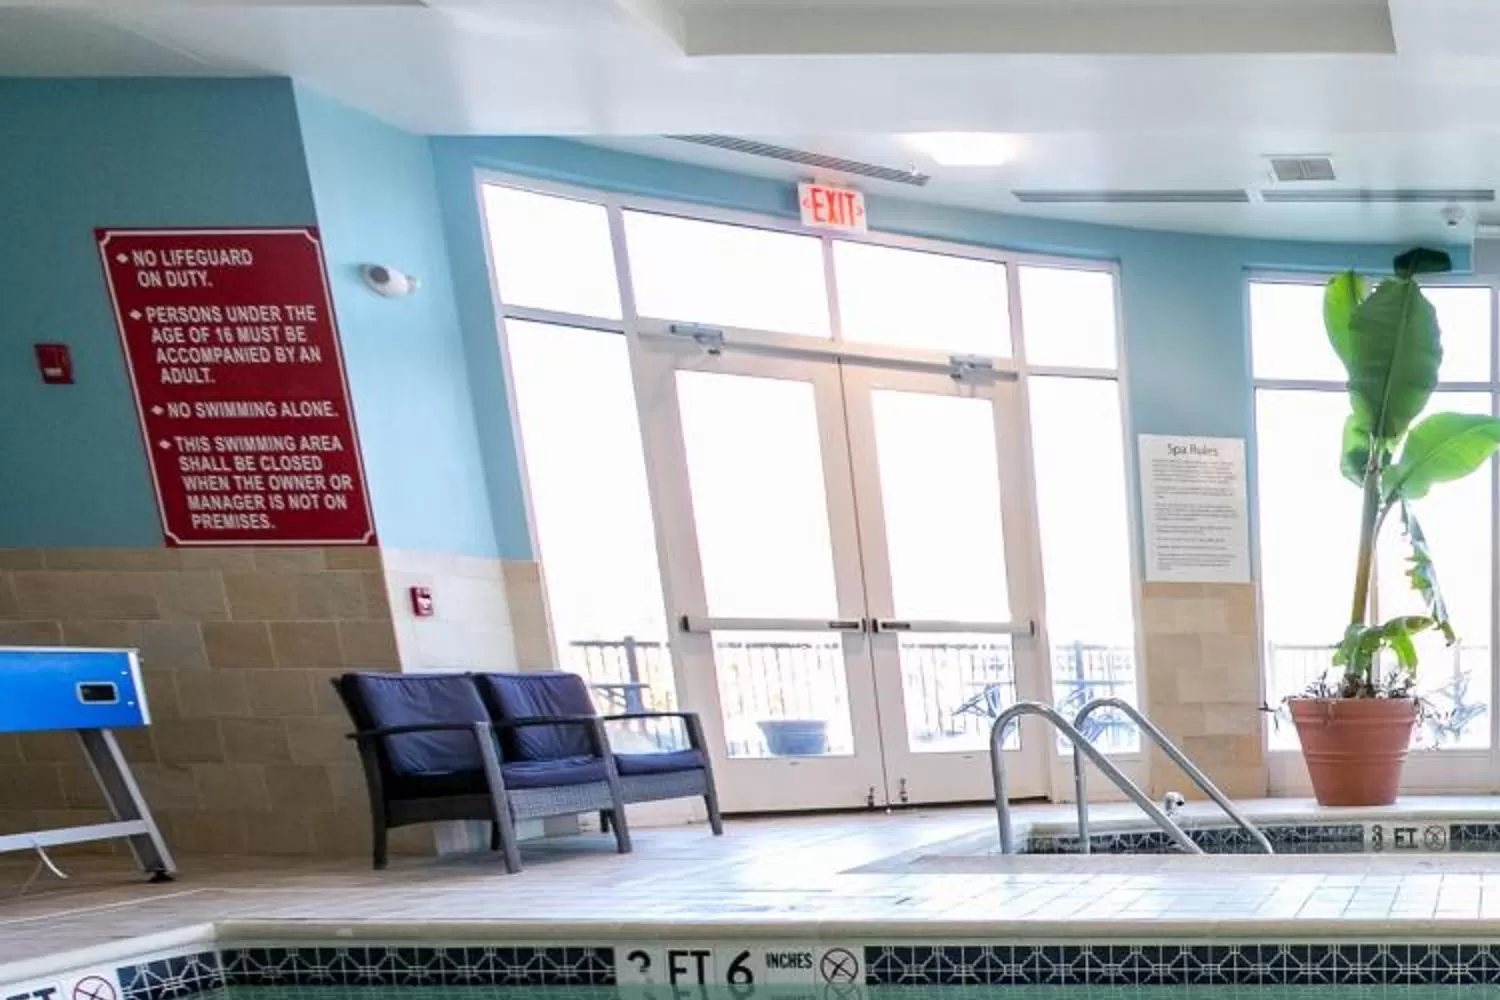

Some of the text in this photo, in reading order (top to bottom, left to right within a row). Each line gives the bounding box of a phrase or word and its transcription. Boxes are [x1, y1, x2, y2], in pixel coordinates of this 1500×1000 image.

[810, 186, 857, 227] EXIT
[132, 248, 253, 266] NO LIFEGUARD
[137, 270, 214, 287] ON DUTY.
[145, 304, 318, 323] PERSONS UNDER THE
[151, 325, 308, 344] AGE OF 16 MUST BE
[156, 346, 322, 364] ACCOMPANIED BY AN
[160, 367, 216, 384] ADULT.
[167, 401, 339, 418] NO SWIMMING ALONE.
[173, 435, 344, 452] THIS SWIMMING AREA
[1167, 443, 1219, 457] Spa Rules
[178, 455, 323, 472] SHALL BE CLOSED
[181, 475, 353, 491] WHEN THE OWNER OR
[186, 494, 348, 510] MANAGER IS NOT ON
[191, 513, 276, 530] PREMISES.
[667, 949, 711, 985] FT
[726, 949, 754, 985] 6
[765, 951, 814, 969] INCHES
